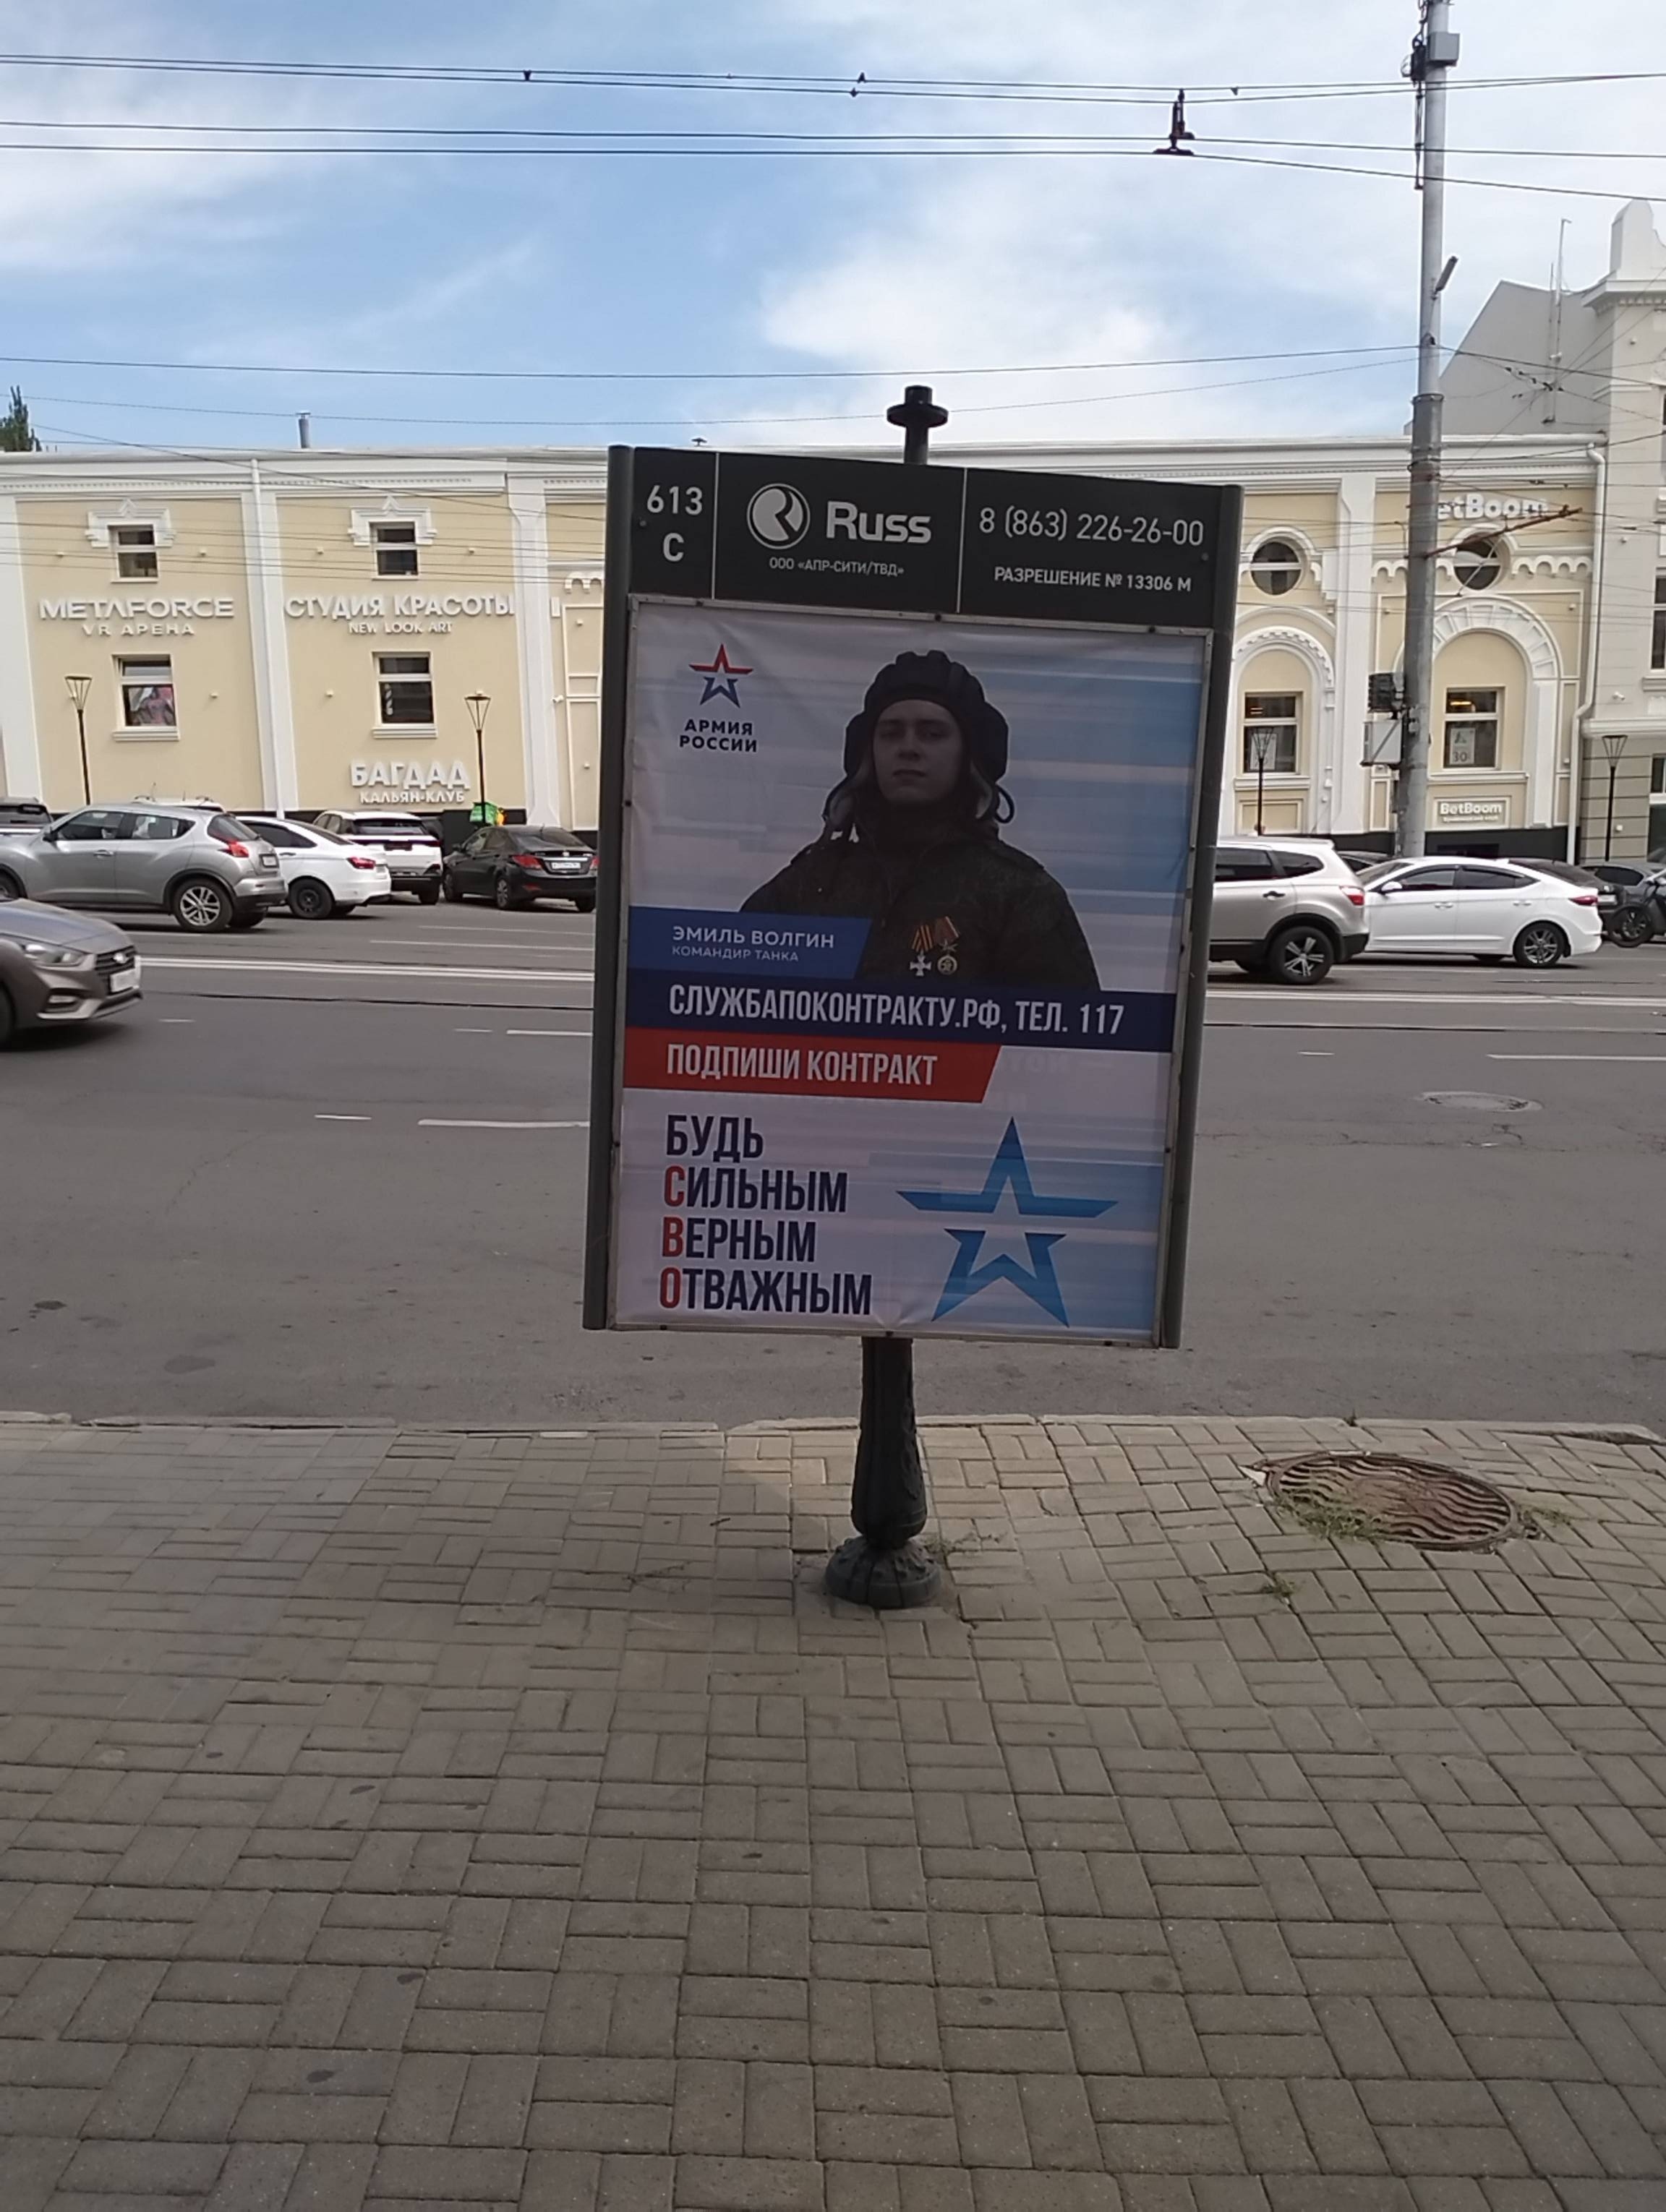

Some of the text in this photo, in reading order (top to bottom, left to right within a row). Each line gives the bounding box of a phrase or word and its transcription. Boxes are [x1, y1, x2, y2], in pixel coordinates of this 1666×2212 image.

[646, 485, 703, 515] 613
[826, 500, 932, 544] Russ
[979, 505, 1204, 546] 8 (863) 226-26-00
[769, 557, 905, 576] ООО «АПР-СИТИ/ТВД»
[994, 567, 1192, 592] РАЗРЕШЕНИЕ № 13306 М
[39, 598, 234, 620] METAFORCE
[284, 594, 516, 621] СТУДИЯ КРАСОТЫ
[82, 623, 195, 637] VR АРЕНА
[349, 622, 453, 634] NEW LOOK ART
[685, 719, 753, 735] АРМИЯ
[679, 735, 757, 753] РОССИИ
[351, 759, 471, 790] БАГДАД
[1440, 802, 1502, 815] BetBoom
[672, 925, 834, 948] ЭМИЛЬ ВОЛГИН
[672, 946, 798, 961] КОМАНДИР ТАНКА
[669, 984, 1124, 1034] СЛУЖБАПОКОНТРАКТУ.РФ, ТЕЛ. 117
[667, 1044, 938, 1085] ПОДПИШИ КОНТРАКТ
[666, 1115, 764, 1163] БУДЬ
[664, 1165, 847, 1212] СИЛЬНЫМ
[662, 1217, 816, 1262] ВЕРНЫМ
[659, 1266, 872, 1315] ОТВАЖНЫМ
